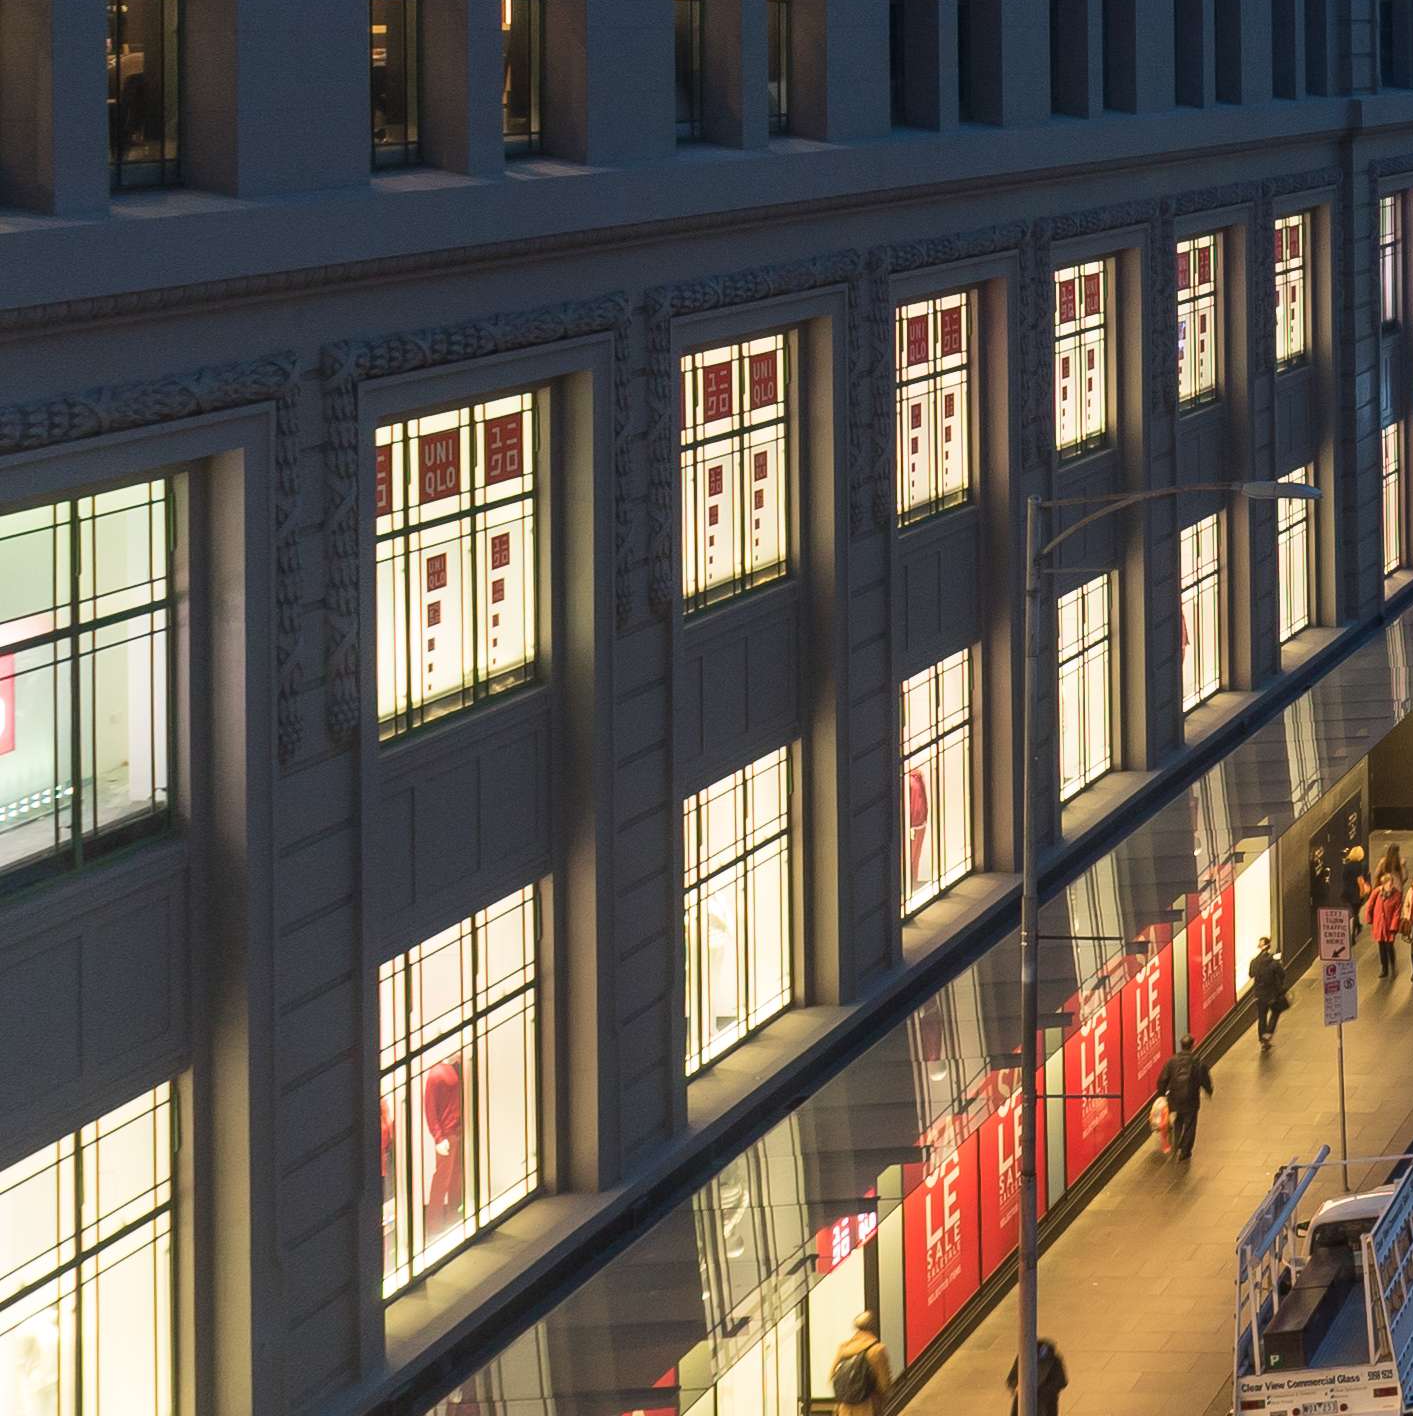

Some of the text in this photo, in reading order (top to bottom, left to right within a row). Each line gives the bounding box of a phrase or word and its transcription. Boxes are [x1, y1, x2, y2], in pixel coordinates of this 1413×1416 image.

[753, 358, 773, 381] UNI
[753, 381, 774, 405] QLO
[424, 439, 454, 467] UNI
[425, 466, 456, 498] QLO
[1136, 968, 1160, 1035] LE
[1137, 1014, 1160, 1051] SALE
[1081, 1021, 1107, 1091] LE
[999, 1158, 1023, 1194] SAL
[925, 1165, 961, 1250] LE
[926, 1221, 961, 1270] SALE
[1241, 1382, 1263, 1393] Clear
[1265, 1379, 1286, 1391] View
[1287, 1376, 1336, 1390] Commercial
[1337, 1373, 1361, 1385] Glass
